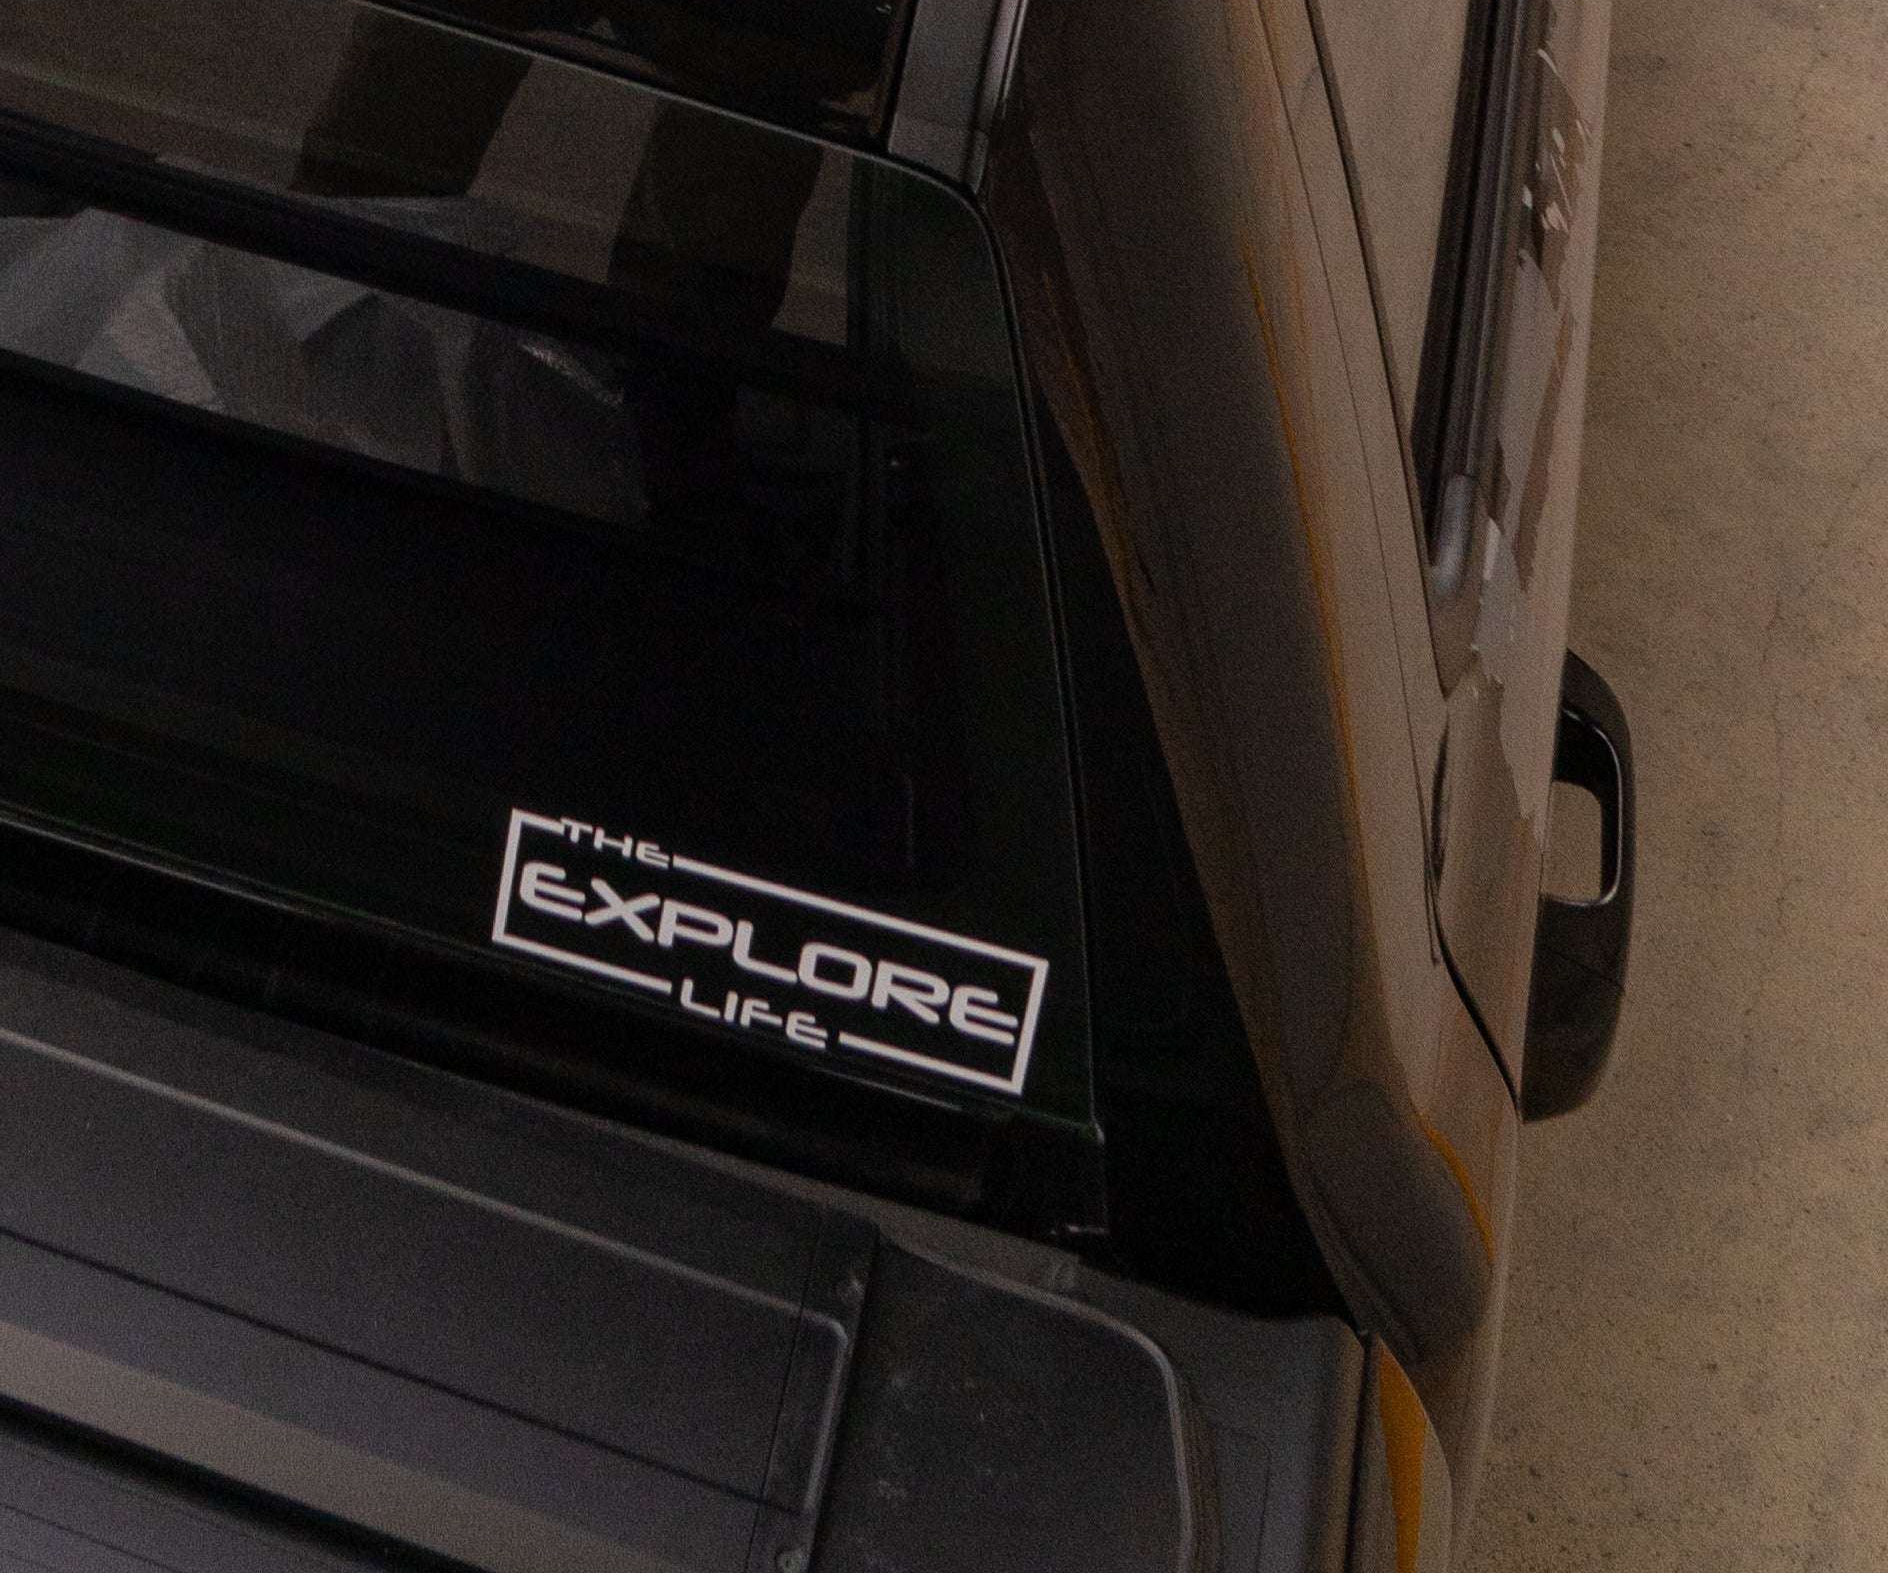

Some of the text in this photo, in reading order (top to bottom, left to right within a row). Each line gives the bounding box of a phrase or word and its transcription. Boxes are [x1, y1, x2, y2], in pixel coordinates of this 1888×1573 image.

[559, 816, 672, 870] THE
[518, 860, 1019, 1047] EXPLORE
[678, 977, 829, 1051] LIFE
